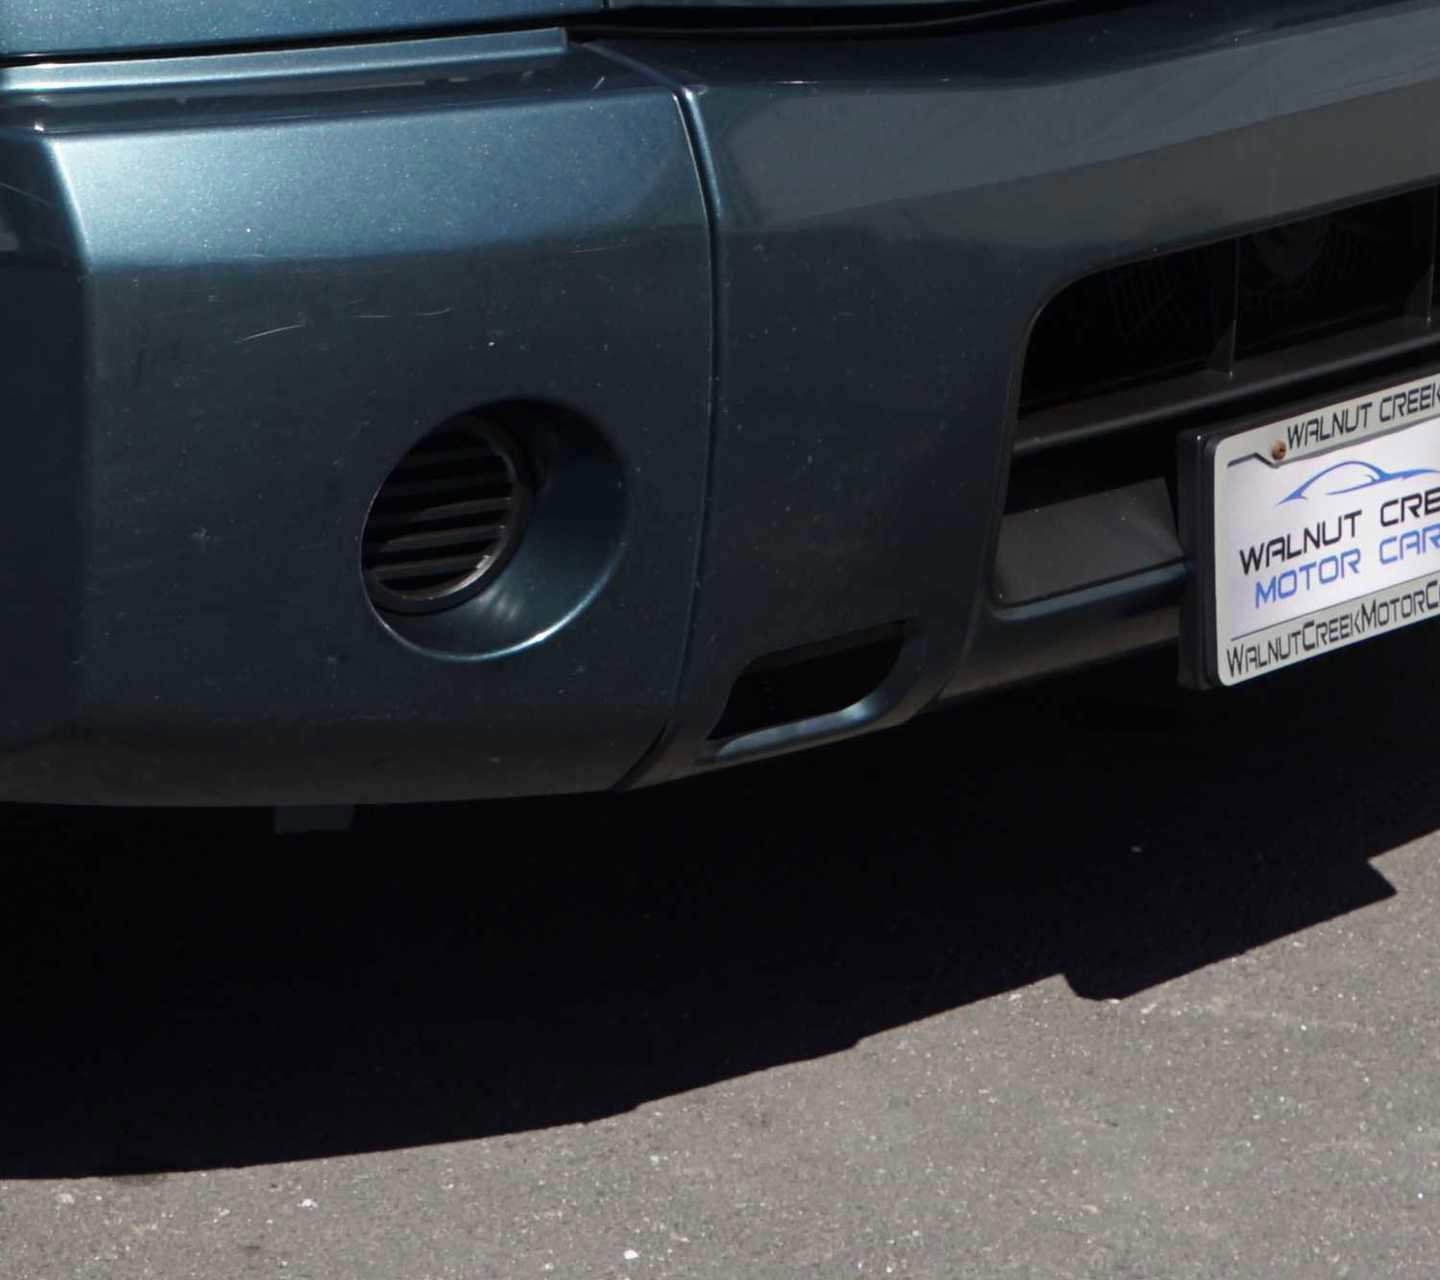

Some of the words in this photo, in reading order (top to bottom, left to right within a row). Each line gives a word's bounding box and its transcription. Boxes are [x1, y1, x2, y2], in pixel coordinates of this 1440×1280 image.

[1287, 402, 1373, 451] WALNUT
[1239, 510, 1363, 576] WALNUT
[1254, 548, 1361, 609] MOTOR
